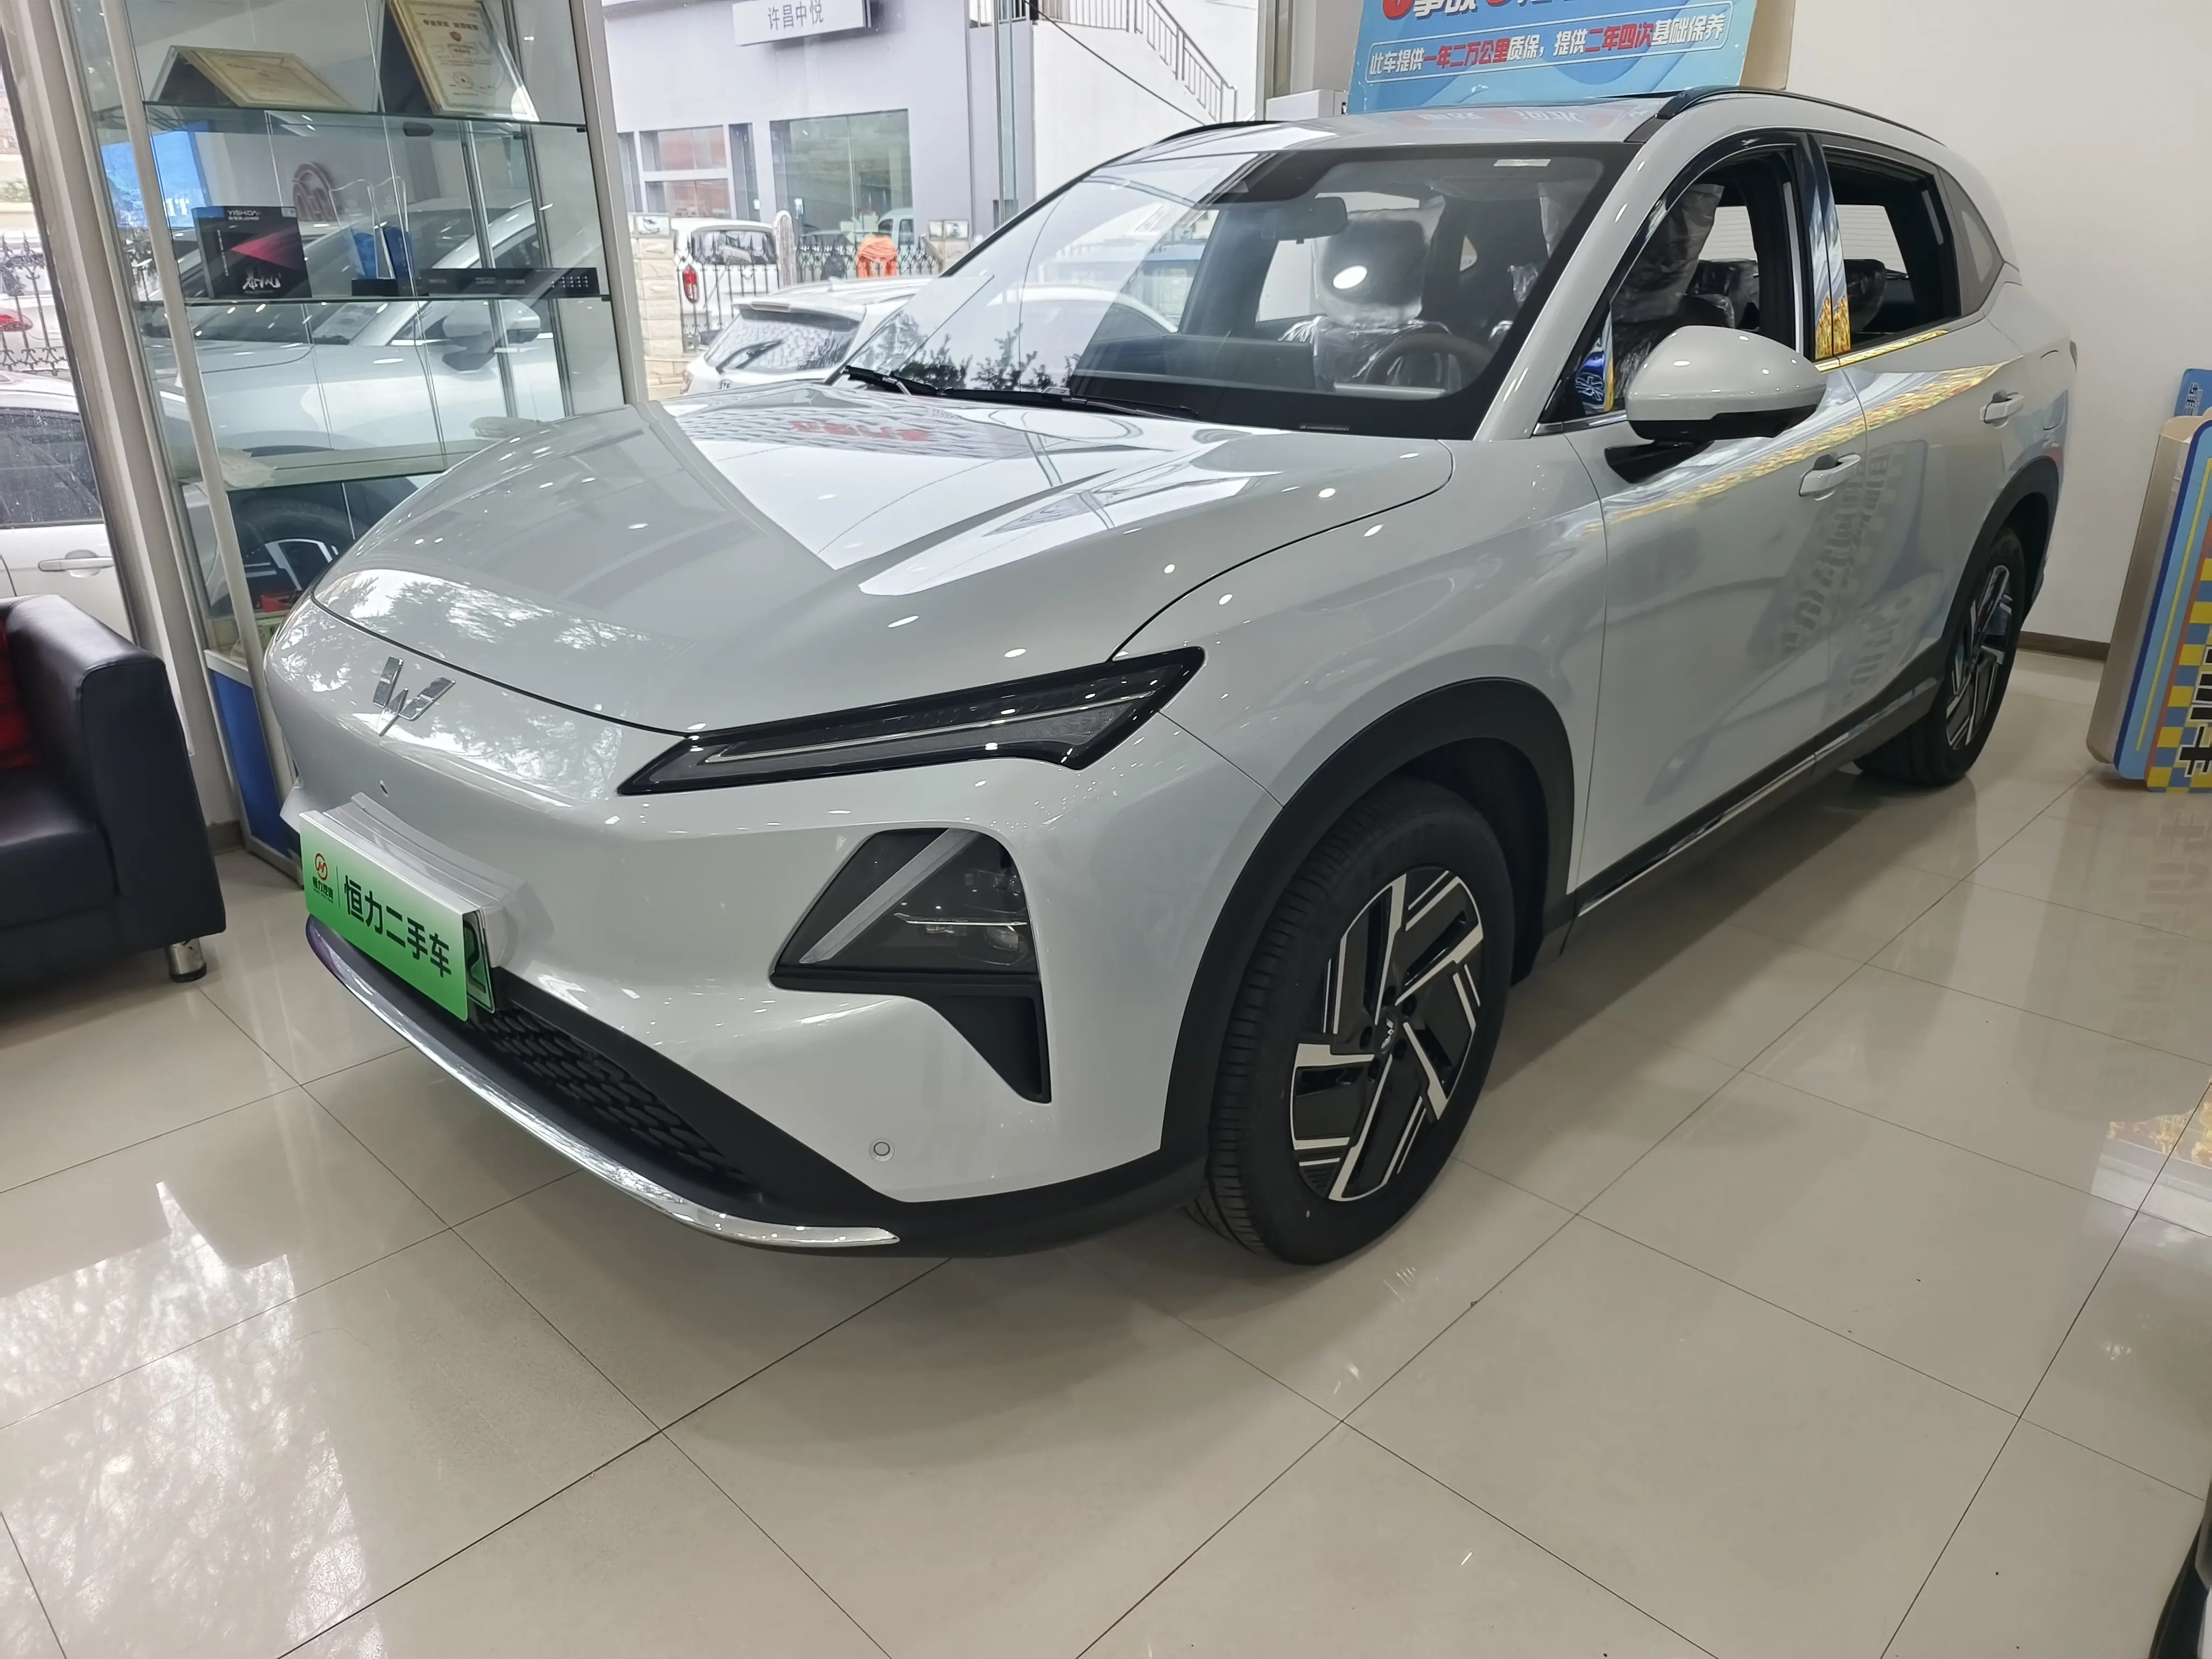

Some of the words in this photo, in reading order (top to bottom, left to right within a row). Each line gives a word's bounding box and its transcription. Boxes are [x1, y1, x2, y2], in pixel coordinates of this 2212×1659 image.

[767, 0, 824, 31] 许昌中悦
[344, 875, 451, 978] 恒力二手车
